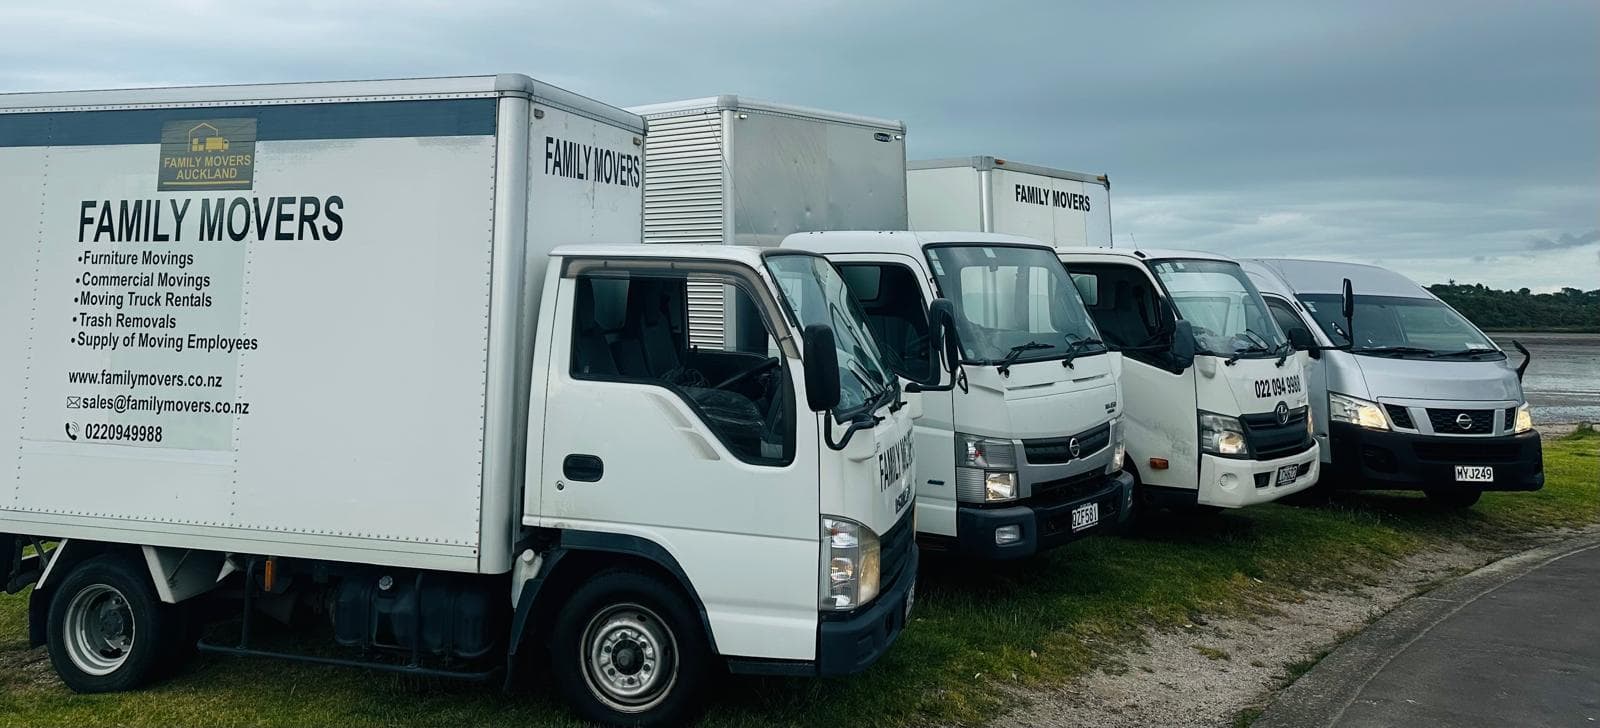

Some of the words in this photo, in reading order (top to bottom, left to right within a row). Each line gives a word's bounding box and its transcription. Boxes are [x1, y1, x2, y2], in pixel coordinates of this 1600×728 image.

[164, 157, 201, 168] FAMILY
[204, 154, 251, 166] MOVERS
[545, 136, 591, 180] FAMILY
[594, 147, 640, 188] MOVERS
[176, 168, 237, 180] AUCKLAND
[1015, 184, 1049, 205] FAMILY
[1053, 190, 1090, 212] MOVERS
[78, 198, 191, 242] FAMILY
[199, 195, 344, 241] MOVERS
[83, 250, 138, 265] Furniture
[141, 251, 194, 268] Movings
[82, 272, 154, 287] Commercial
[157, 273, 210, 290] Movings
[80, 291, 124, 309] Moving
[128, 292, 162, 307] Truck
[165, 292, 212, 307] Rentals
[80, 313, 112, 327] Trash
[116, 314, 176, 328] Removals
[77, 332, 119, 350] Supply
[122, 333, 136, 347] of
[138, 333, 183, 352] Moving
[187, 334, 258, 353] Employees
[68, 369, 223, 389] www.familymovers.co.nz
[1255, 380, 1271, 398] 022
[1272, 377, 1286, 396] 094
[82, 395, 249, 415] sales@familymovers.co.nz
[85, 423, 163, 442] 0220949988
